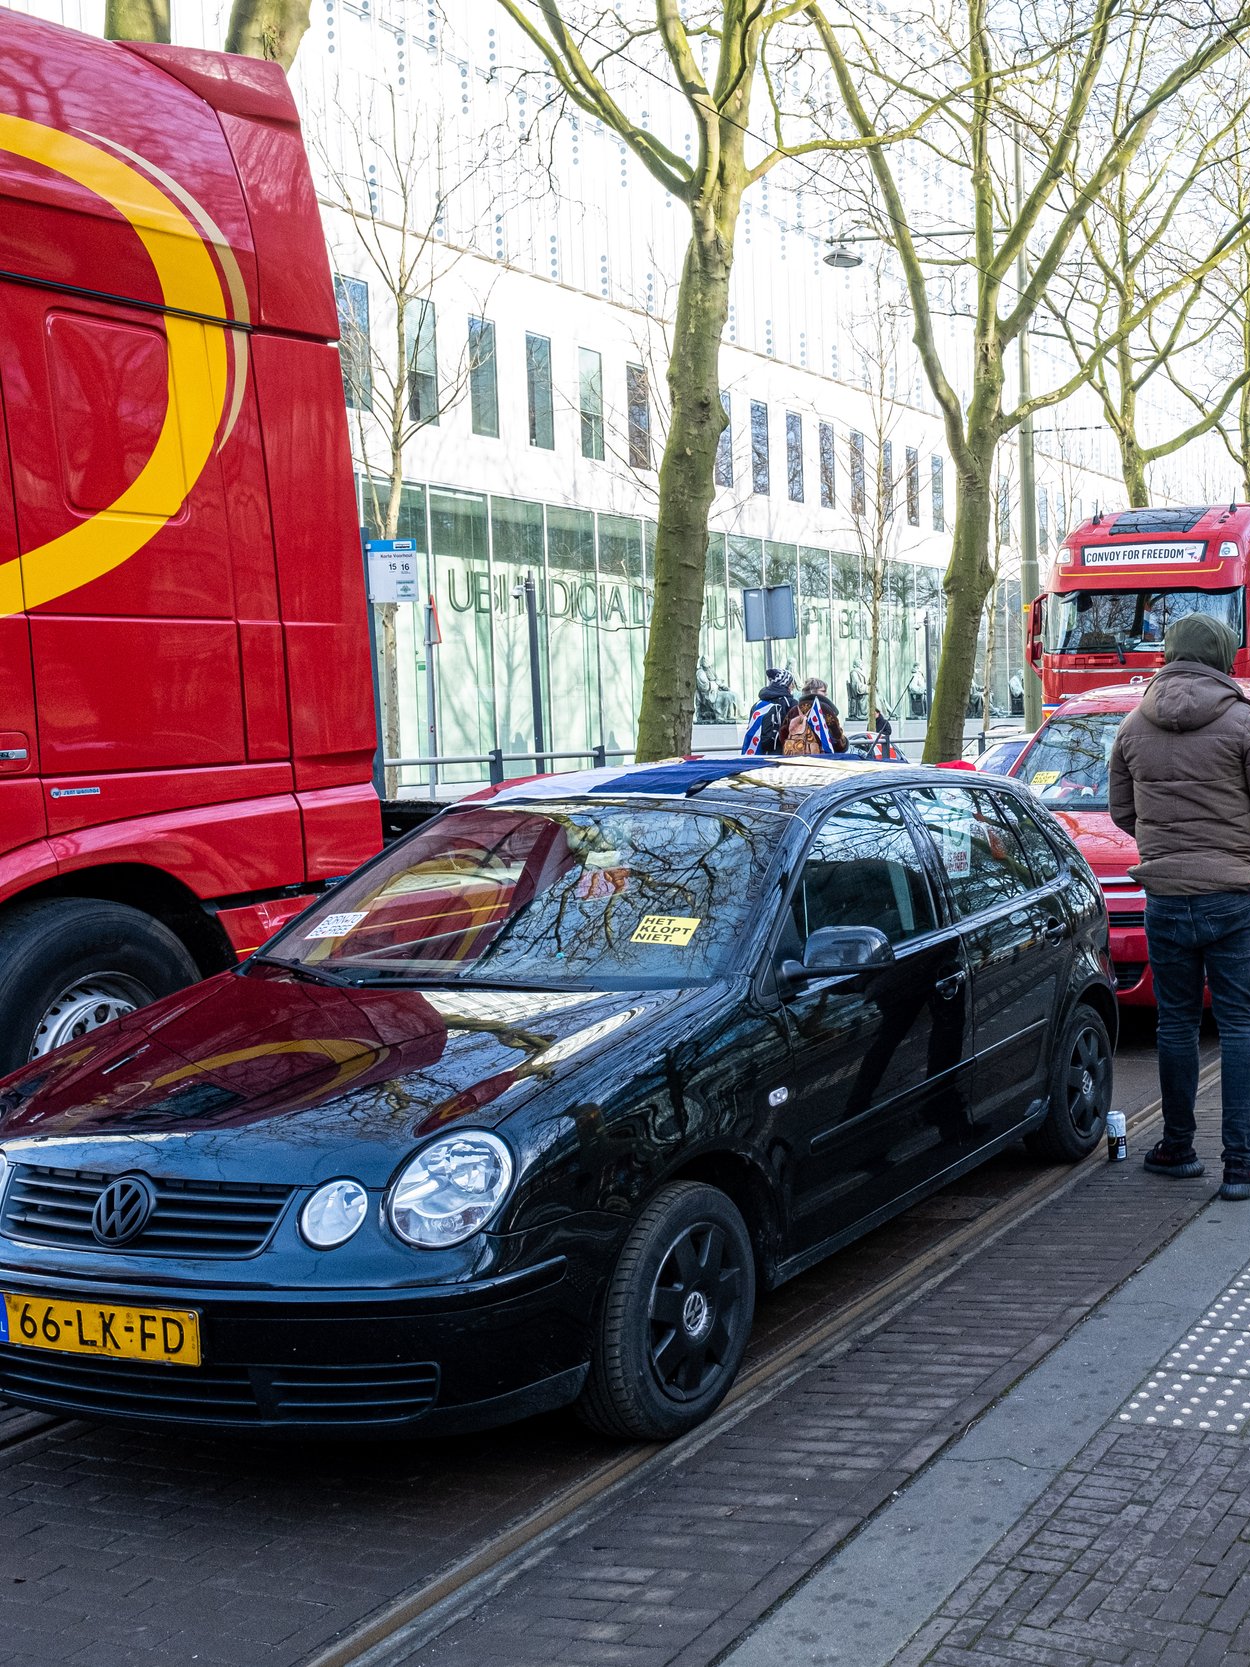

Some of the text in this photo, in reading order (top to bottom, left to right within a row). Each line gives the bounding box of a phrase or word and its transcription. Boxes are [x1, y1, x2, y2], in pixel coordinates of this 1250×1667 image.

[1086, 548, 1185, 563] CONVOY FOR FREEDOM
[401, 563, 410, 571] 16
[644, 917, 676, 926] HET
[639, 925, 692, 935] KLOPT
[634, 933, 673, 943] NIET.
[20, 1302, 185, 1354] 66-LK-FD
